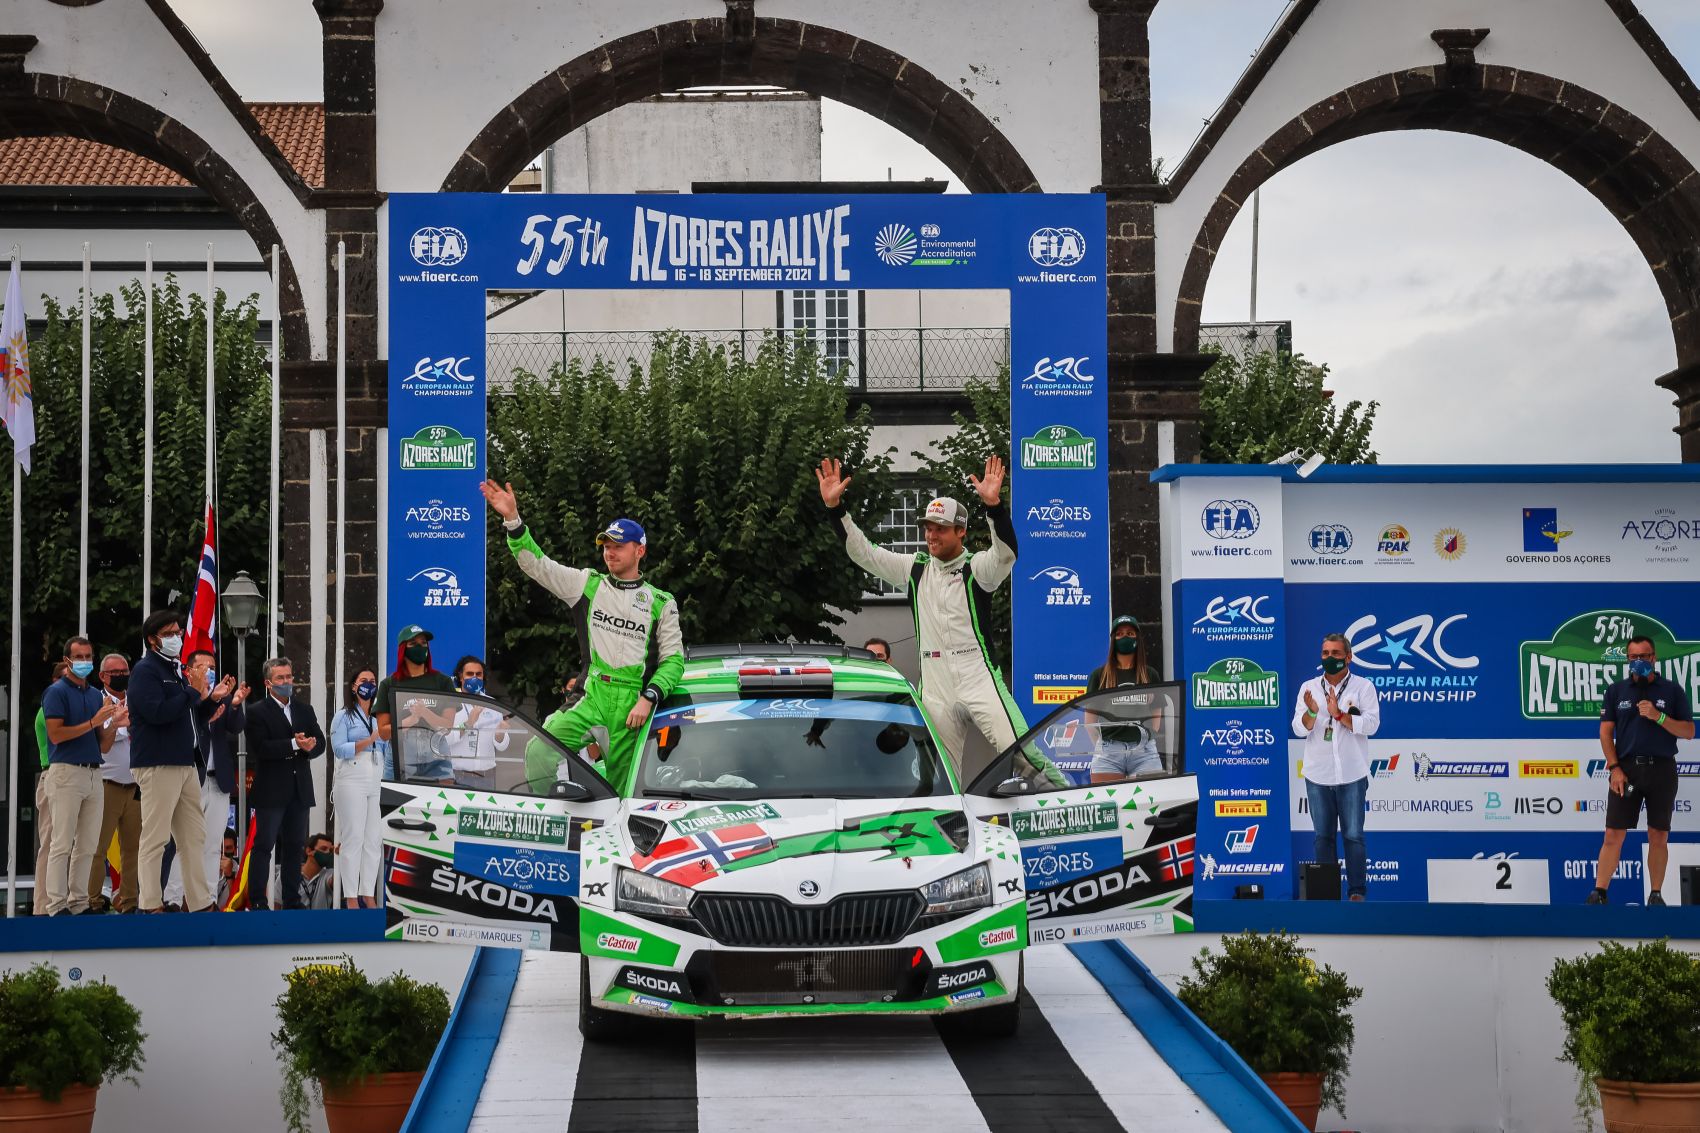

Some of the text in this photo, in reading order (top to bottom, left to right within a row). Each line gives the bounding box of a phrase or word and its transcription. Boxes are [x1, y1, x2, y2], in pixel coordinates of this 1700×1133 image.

[516, 214, 608, 276] 55th
[630, 204, 850, 282] AZORES RALLYE
[922, 239, 976, 248] Environmental
[920, 248, 976, 257] Accreditation
[399, 270, 478, 282] www.fiaerc.com
[674, 268, 687, 281] 16
[699, 268, 712, 281] 18
[714, 269, 783, 281] SEPTEMBER
[785, 268, 812, 281] 2021
[1018, 272, 1096, 283] www.fiaerc.com
[402, 442, 474, 468] AZORES RALLYE
[1024, 442, 1094, 466] AZORES RALLYE
[406, 507, 470, 521] AZORES
[1027, 506, 1092, 520] AZORES
[1206, 508, 1254, 530] FiA
[1622, 519, 1700, 540] AZORE
[1311, 531, 1348, 548] FiA
[1377, 541, 1410, 552] FPAK
[1191, 546, 1272, 556] www.fiaerc.com
[1291, 557, 1364, 566] www.fiaerc.com
[1574, 555, 1611, 565] AÇORES
[424, 596, 469, 606] BRAVE
[1046, 595, 1092, 605] BRAVE
[592, 608, 646, 635] ŠKODA
[592, 622, 646, 642] www.skoda-auto.com
[1594, 616, 1634, 644] 55th
[1431, 676, 1478, 686] RALLY
[1196, 676, 1276, 706] AZORES RALLYE
[1378, 690, 1477, 702] MPIONSHIP
[1564, 702, 1574, 712] 16
[658, 726, 670, 748] 1
[1200, 729, 1274, 746] AZORES
[1433, 764, 1506, 774] MICHELIN
[1524, 763, 1574, 775] PIRELLI
[1250, 788, 1272, 796] Partner
[1220, 804, 1262, 814] PIRELLI
[1514, 797, 1564, 814] MEO
[476, 810, 514, 832] AZORES
[516, 813, 551, 836] RALLYE
[676, 804, 774, 833] AZORES RALLYE
[1030, 808, 1068, 832] AZORES
[1068, 803, 1102, 827] RALLYE
[1103, 816, 1116, 824] 2021
[484, 856, 570, 883] AZORES
[1218, 863, 1284, 872] MICHELIN
[1564, 860, 1642, 880] GOT TENT?
[1496, 862, 1512, 890] 2
[430, 864, 559, 922] ŠKODA
[1026, 864, 1151, 920] ŠKODA
[407, 924, 439, 937] MEO
[988, 928, 1015, 944] Castrol
[1034, 928, 1065, 942] MEO
[608, 936, 638, 951] Castrol
[626, 970, 682, 994] ŠKODA
[938, 968, 987, 989] ŠKODA
[958, 990, 982, 1000] MICHELIN
[640, 998, 668, 1008] MICHELIN
